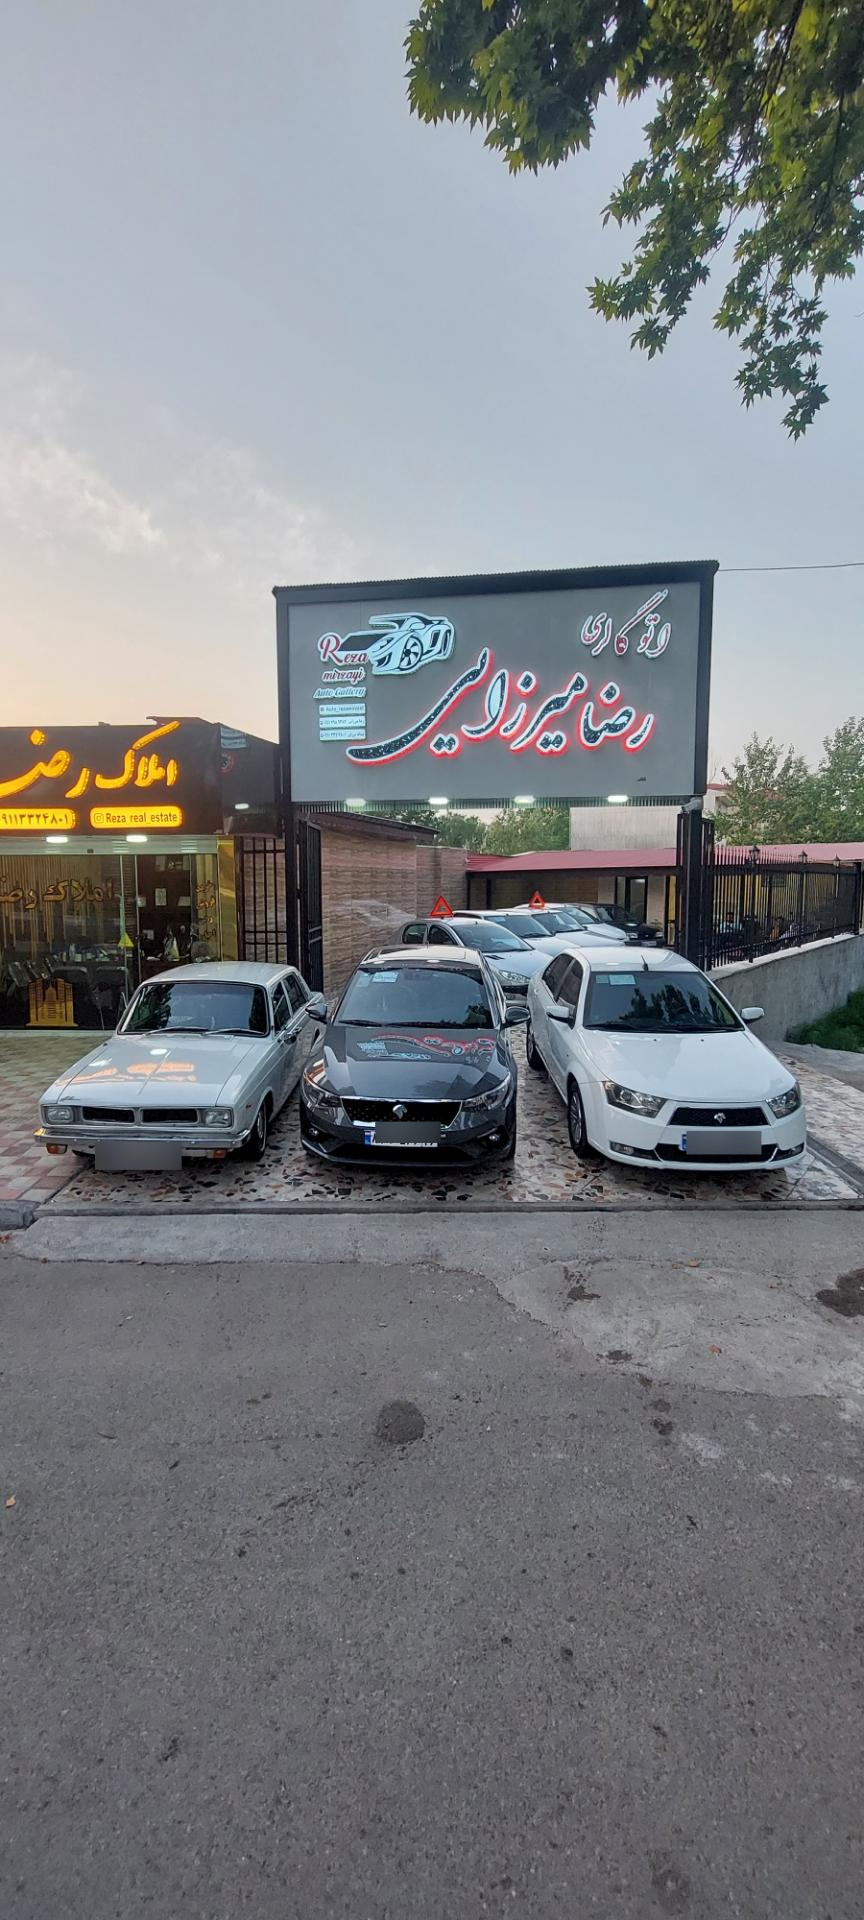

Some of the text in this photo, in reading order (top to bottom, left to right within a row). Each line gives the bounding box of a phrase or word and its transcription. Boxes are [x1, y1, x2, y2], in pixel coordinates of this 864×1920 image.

[581, 589, 671, 657] اتو گالری
[318, 632, 368, 665] Reza
[314, 688, 335, 698] Auto
[322, 667, 366, 684] mirzayi
[346, 647, 655, 762] رضا میرزایی
[0, 720, 180, 799] املاک رض
